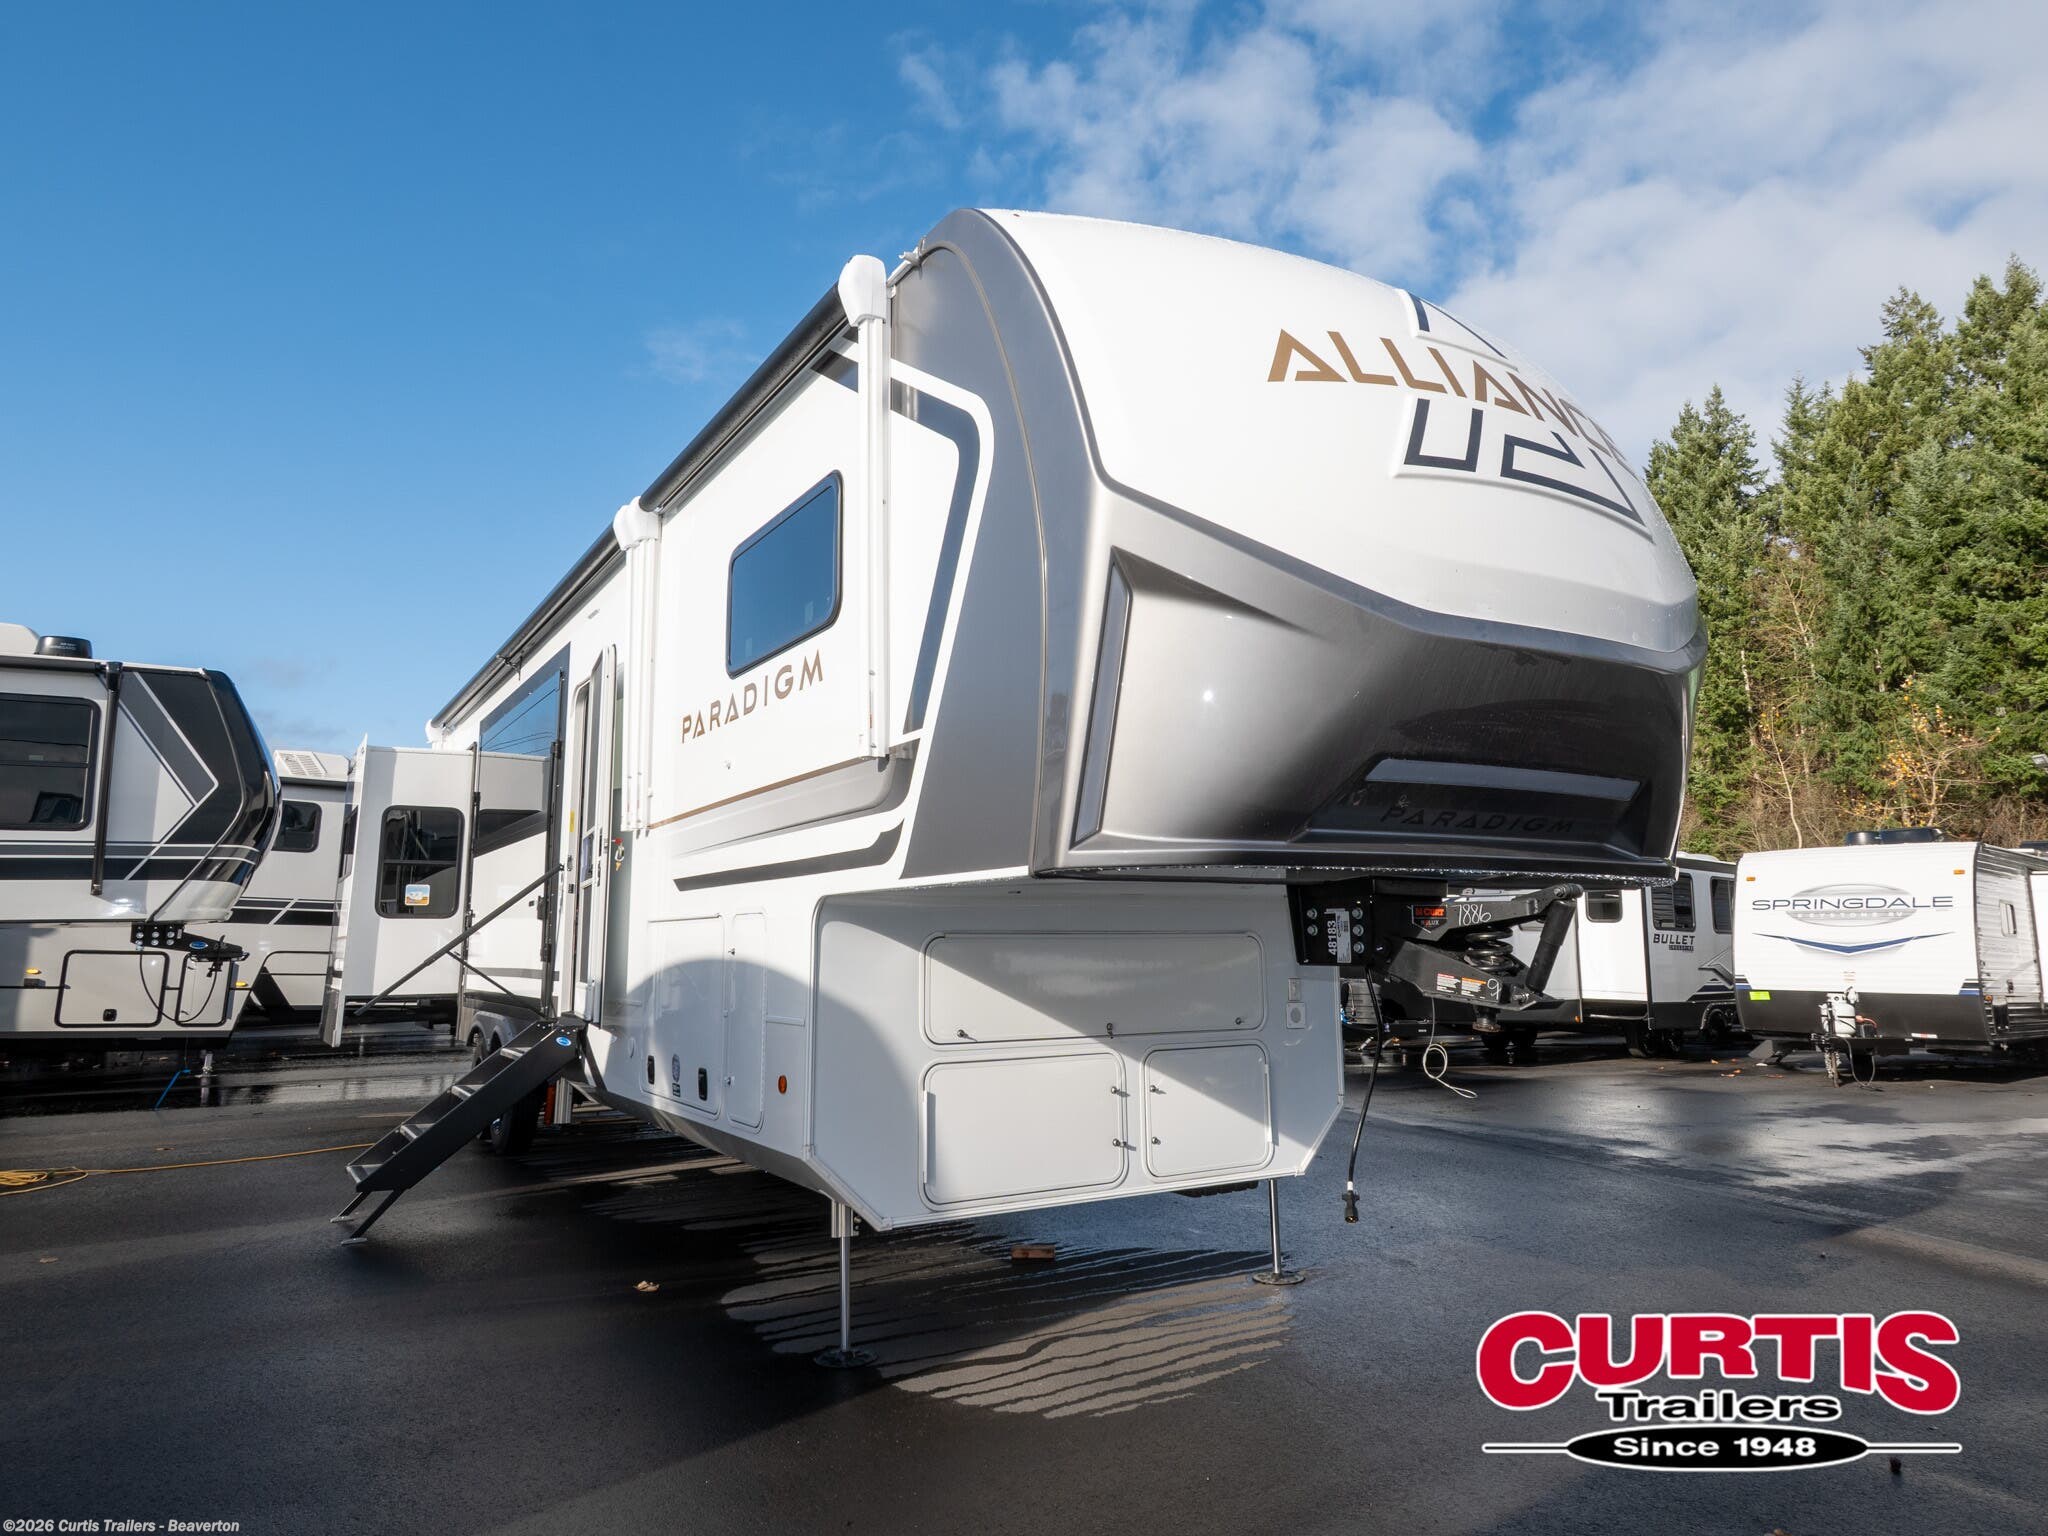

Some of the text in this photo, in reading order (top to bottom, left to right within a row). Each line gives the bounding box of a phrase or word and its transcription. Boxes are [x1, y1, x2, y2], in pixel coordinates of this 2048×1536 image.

[681, 649, 823, 744] PARADIGM
[1379, 807, 1576, 833] PARADIGM
[1752, 896, 1954, 911] SPRINGDALE
[1327, 920, 1337, 956] 48183
[1653, 933, 1696, 945] BULLET
